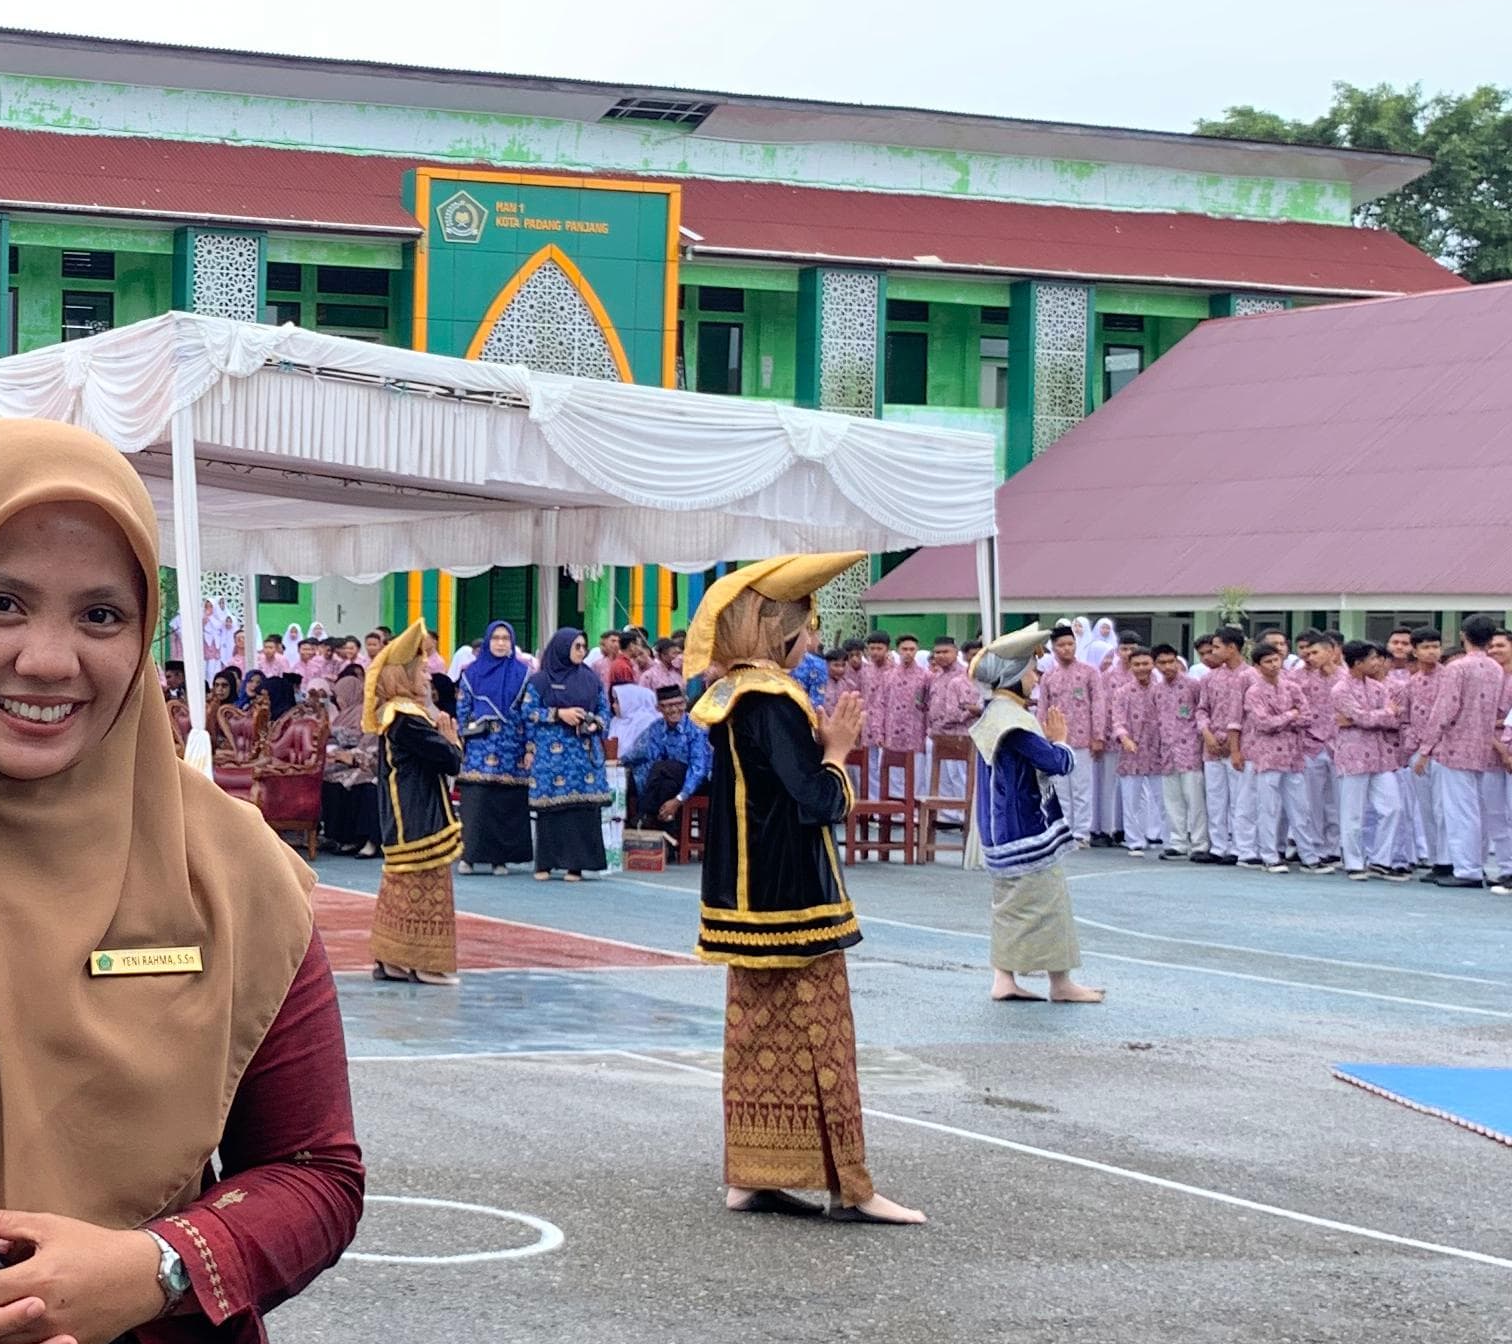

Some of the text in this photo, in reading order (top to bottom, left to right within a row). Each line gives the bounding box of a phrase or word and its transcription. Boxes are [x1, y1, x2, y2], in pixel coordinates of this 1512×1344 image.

[496, 201, 524, 214] MAN 1
[496, 216, 609, 234] KOTA PADANG PANJANG
[122, 956, 140, 967] YENI
